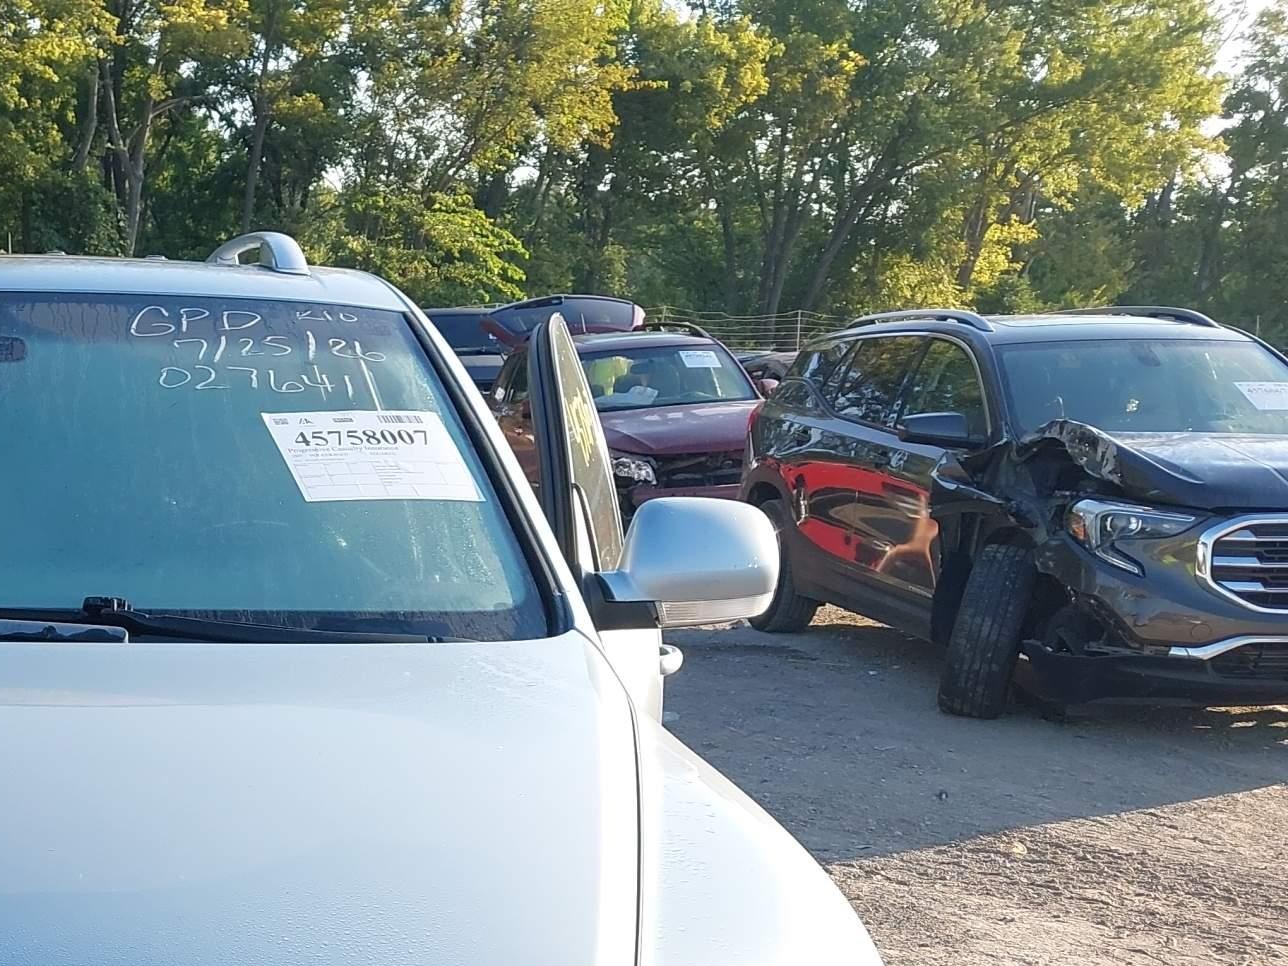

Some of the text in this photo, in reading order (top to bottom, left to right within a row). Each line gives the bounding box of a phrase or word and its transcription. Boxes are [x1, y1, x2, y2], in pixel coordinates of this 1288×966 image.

[130, 305, 262, 337] GPD
[173, 330, 386, 363] 7/25/26
[294, 429, 428, 447] 45758007
